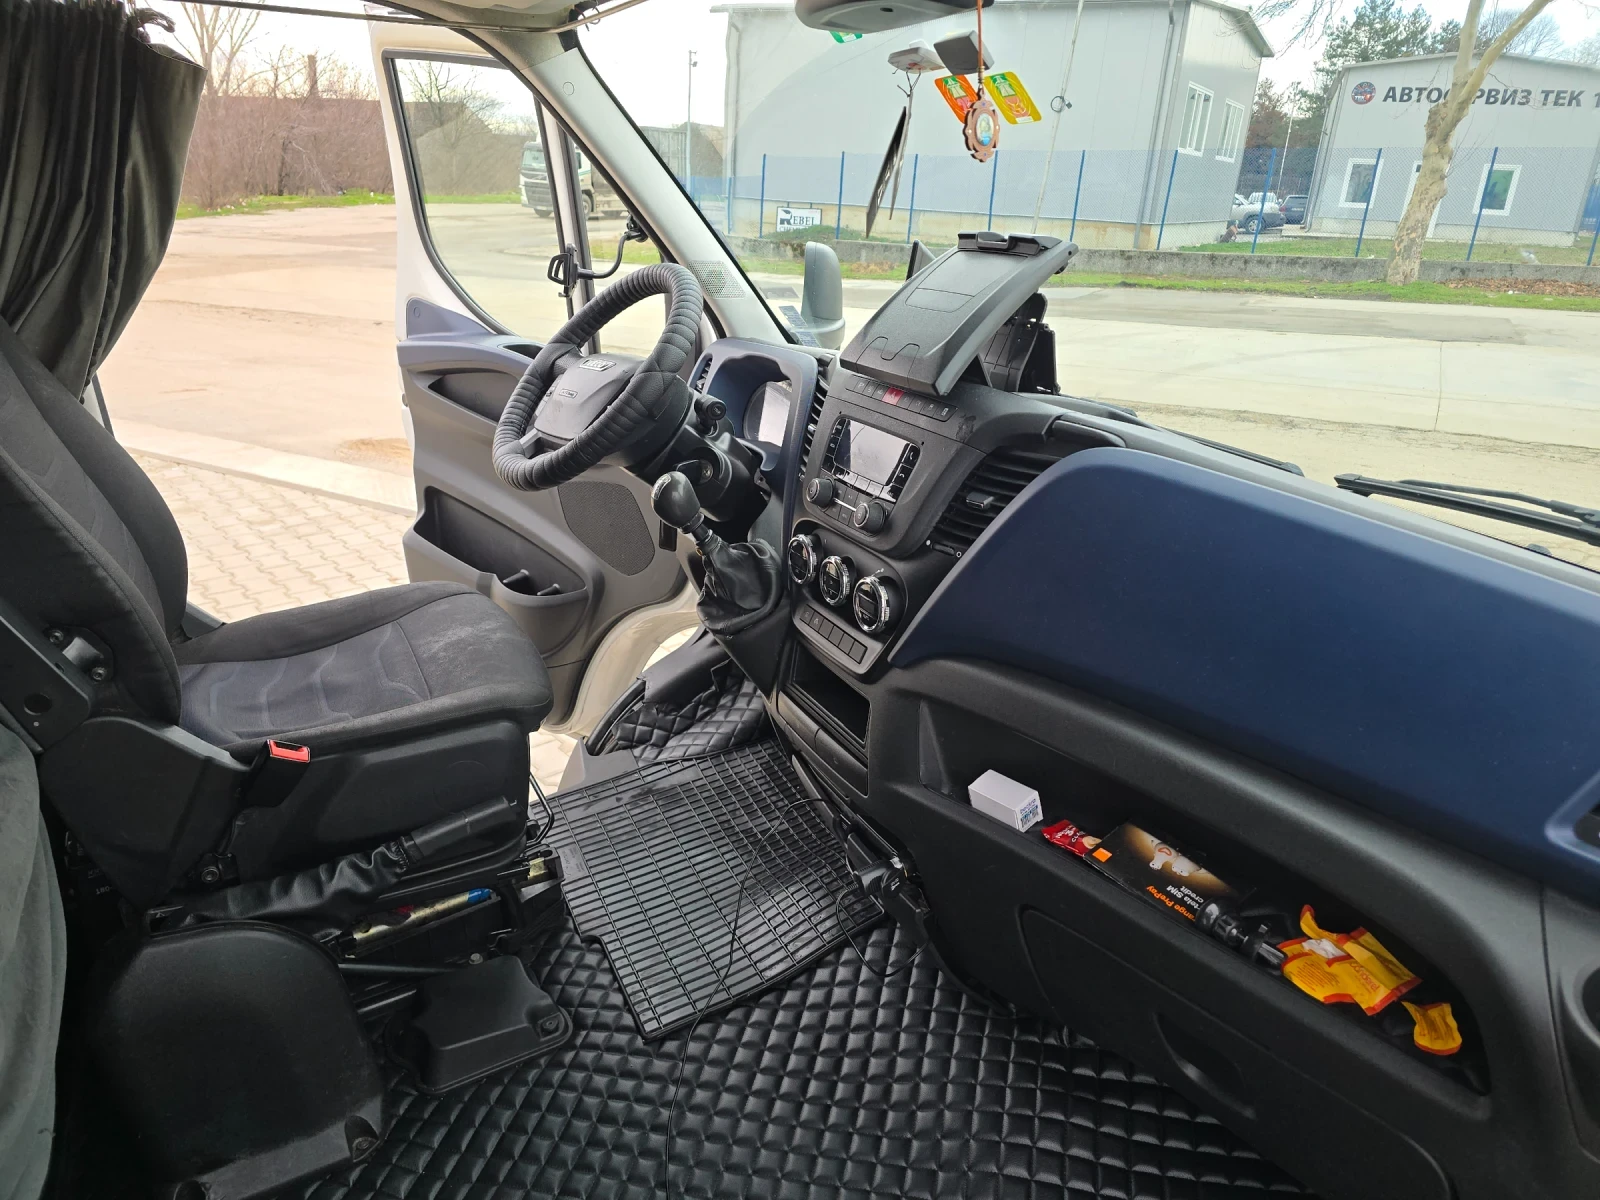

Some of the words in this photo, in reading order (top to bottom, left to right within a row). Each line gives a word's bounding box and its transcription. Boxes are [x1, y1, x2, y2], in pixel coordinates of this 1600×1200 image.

[1382, 86, 1532, 106] АВТОРВИЗ
[1541, 89, 1586, 107] ТЕК
[1146, 885, 1175, 907] PrePay
[1166, 885, 1184, 899] SIM
[1180, 885, 1204, 903] credit
